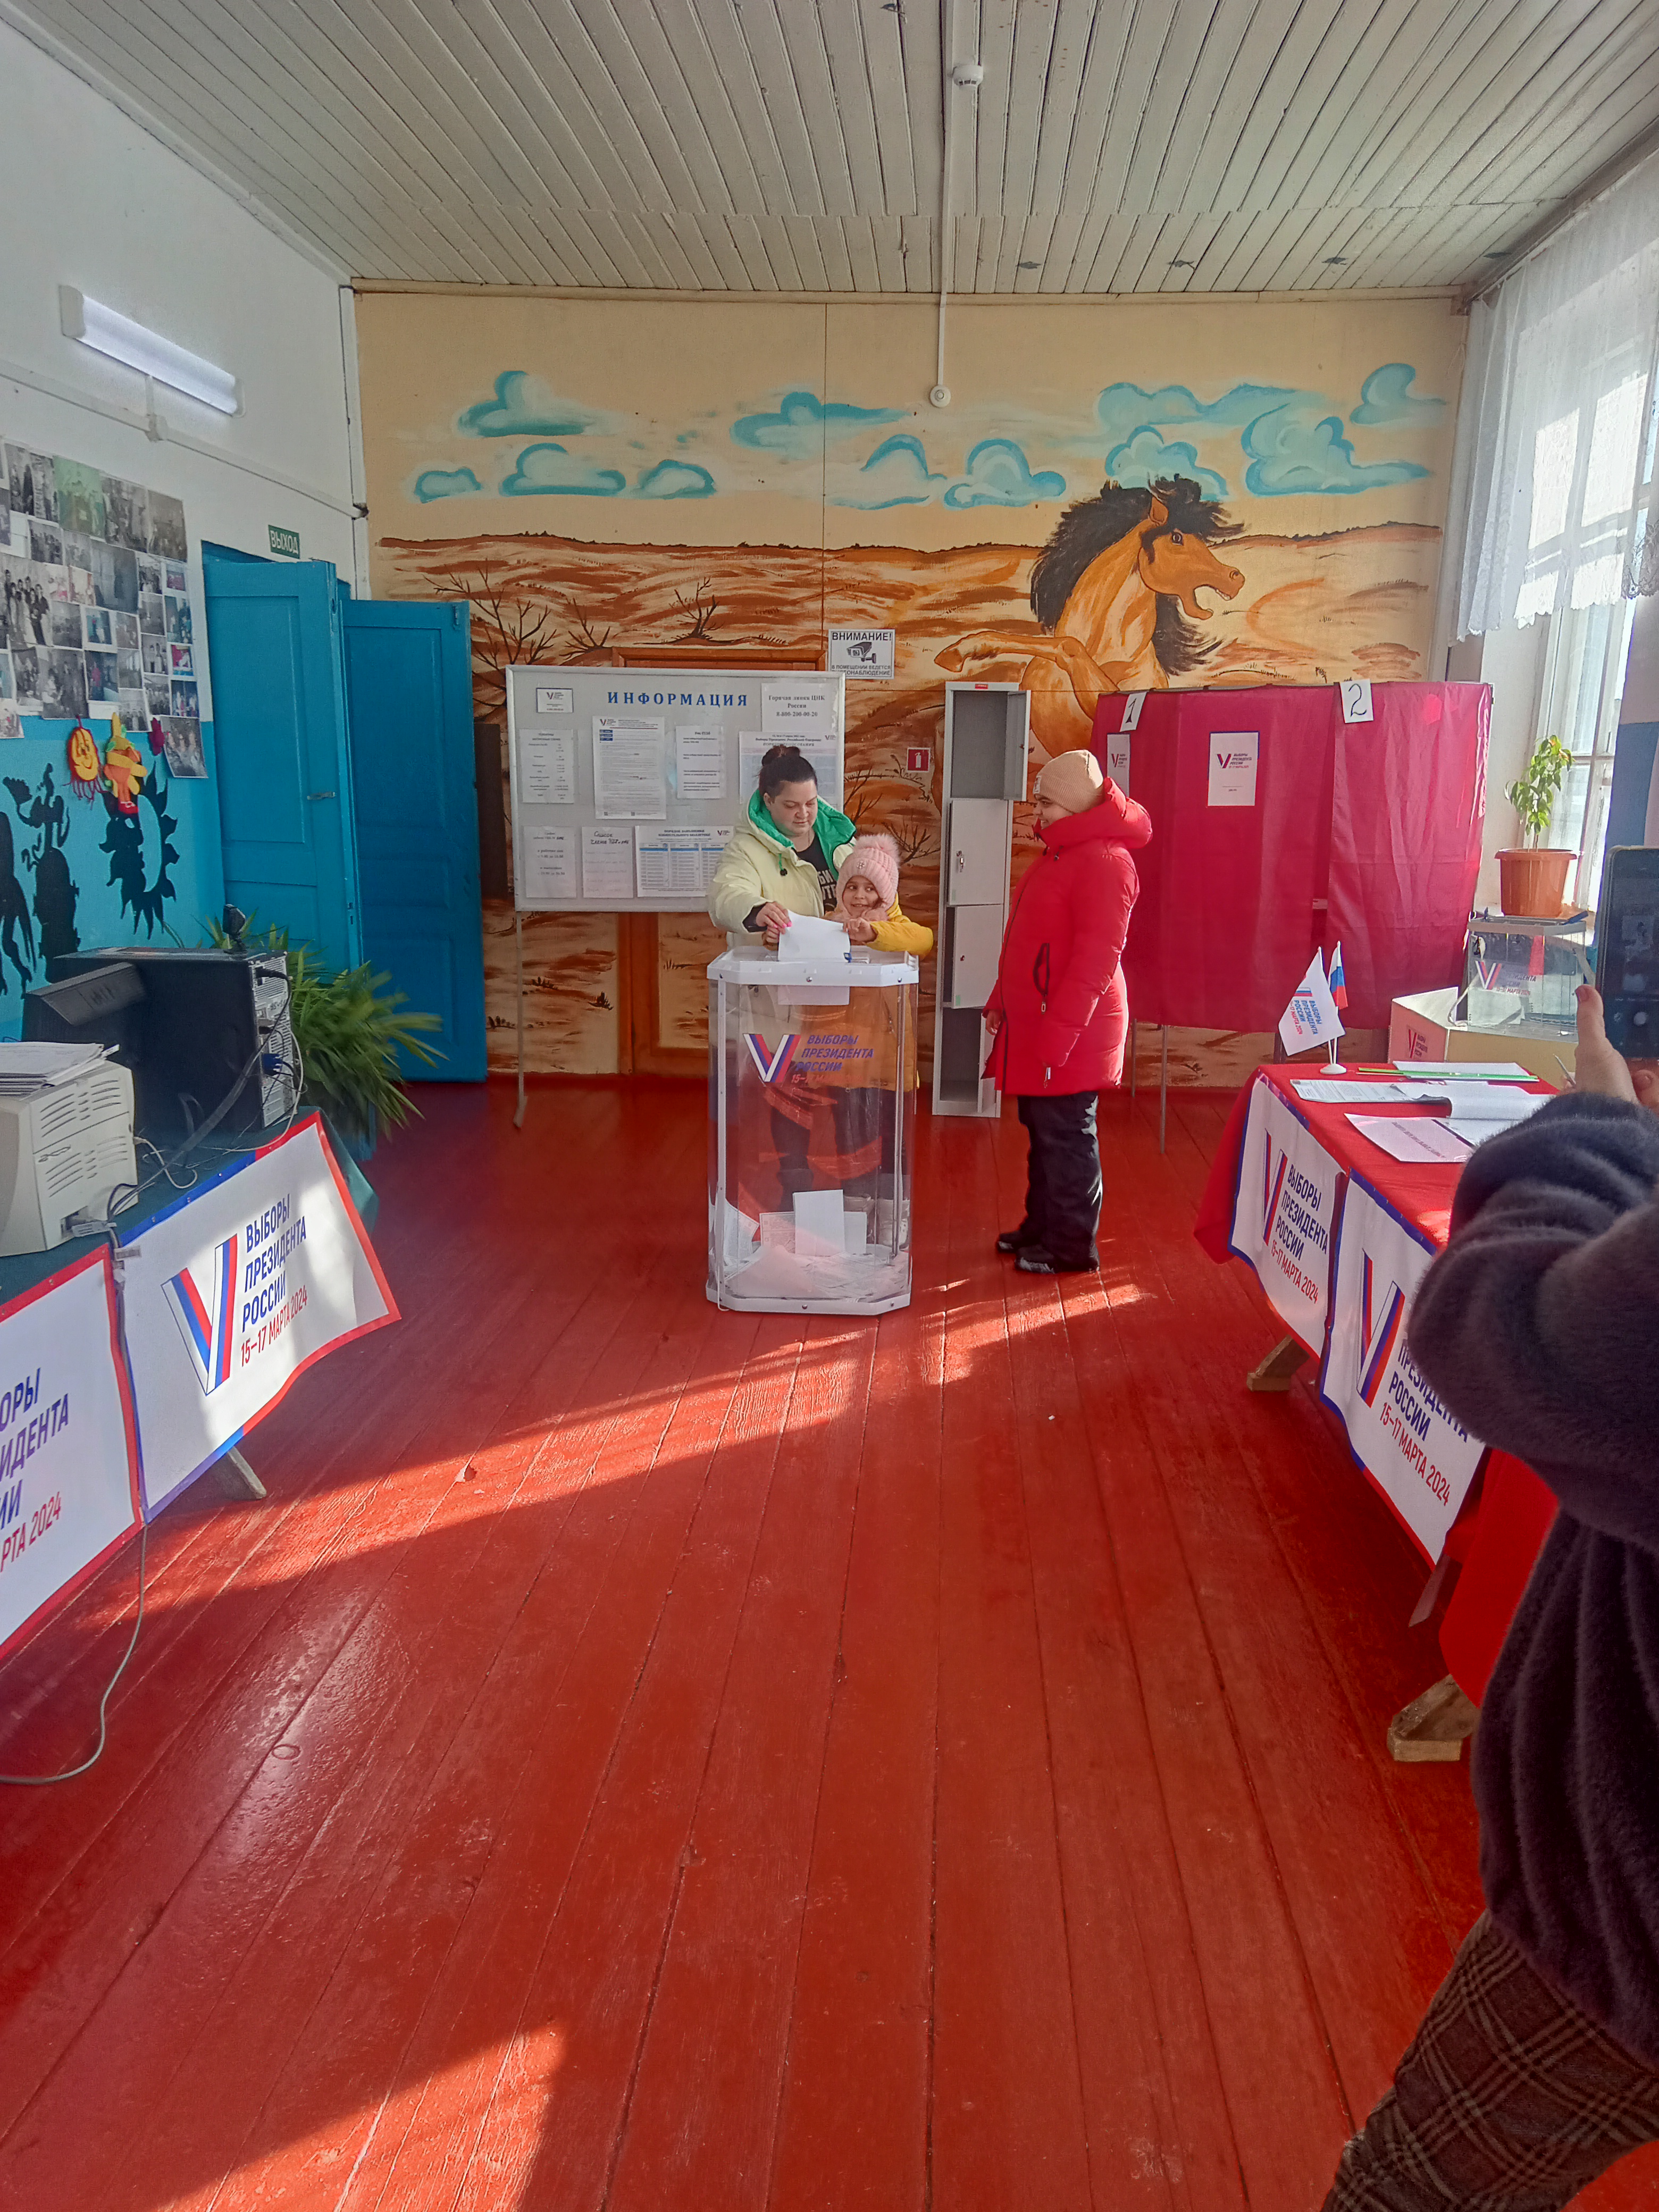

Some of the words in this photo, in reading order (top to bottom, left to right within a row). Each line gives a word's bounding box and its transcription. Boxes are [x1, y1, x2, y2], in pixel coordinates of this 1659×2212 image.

[270, 530, 298, 555] ВЫХОД
[832, 632, 892, 641] ВНИМАНИЕ!
[607, 692, 747, 708] ИНФОРМАЦИЯ
[1125, 698, 1137, 724] 1
[1348, 683, 1367, 717] 2
[1294, 1000, 1306, 1022] РОССИИ
[801, 1048, 874, 1059] ПРЕЗИДЕНТА
[807, 1035, 859, 1044] ВЫБОРЫ
[795, 1062, 843, 1071] РОССИИ
[1287, 1164, 1321, 1211] ВЫБОРЫ
[246, 1193, 290, 1253] ВЫБОРЫ
[1276, 1215, 1304, 1261] РОССИИ
[1281, 1189, 1328, 1254] ПРЕЗИДЕНТА
[245, 1216, 306, 1293] ПРЕЗИДЕНТА
[242, 1270, 286, 1333] РОССИИ
[1281, 1254, 1302, 1288] МАРТА
[1301, 1276, 1318, 1304] 2024
[269, 1302, 290, 1345] МАРТА
[291, 1285, 307, 1320] 2024
[1388, 1371, 1431, 1442] РОССИИ
[1399, 1428, 1427, 1479] МАРТА
[1426, 1464, 1450, 1506] 2024
[29, 1491, 61, 1546] 2024
